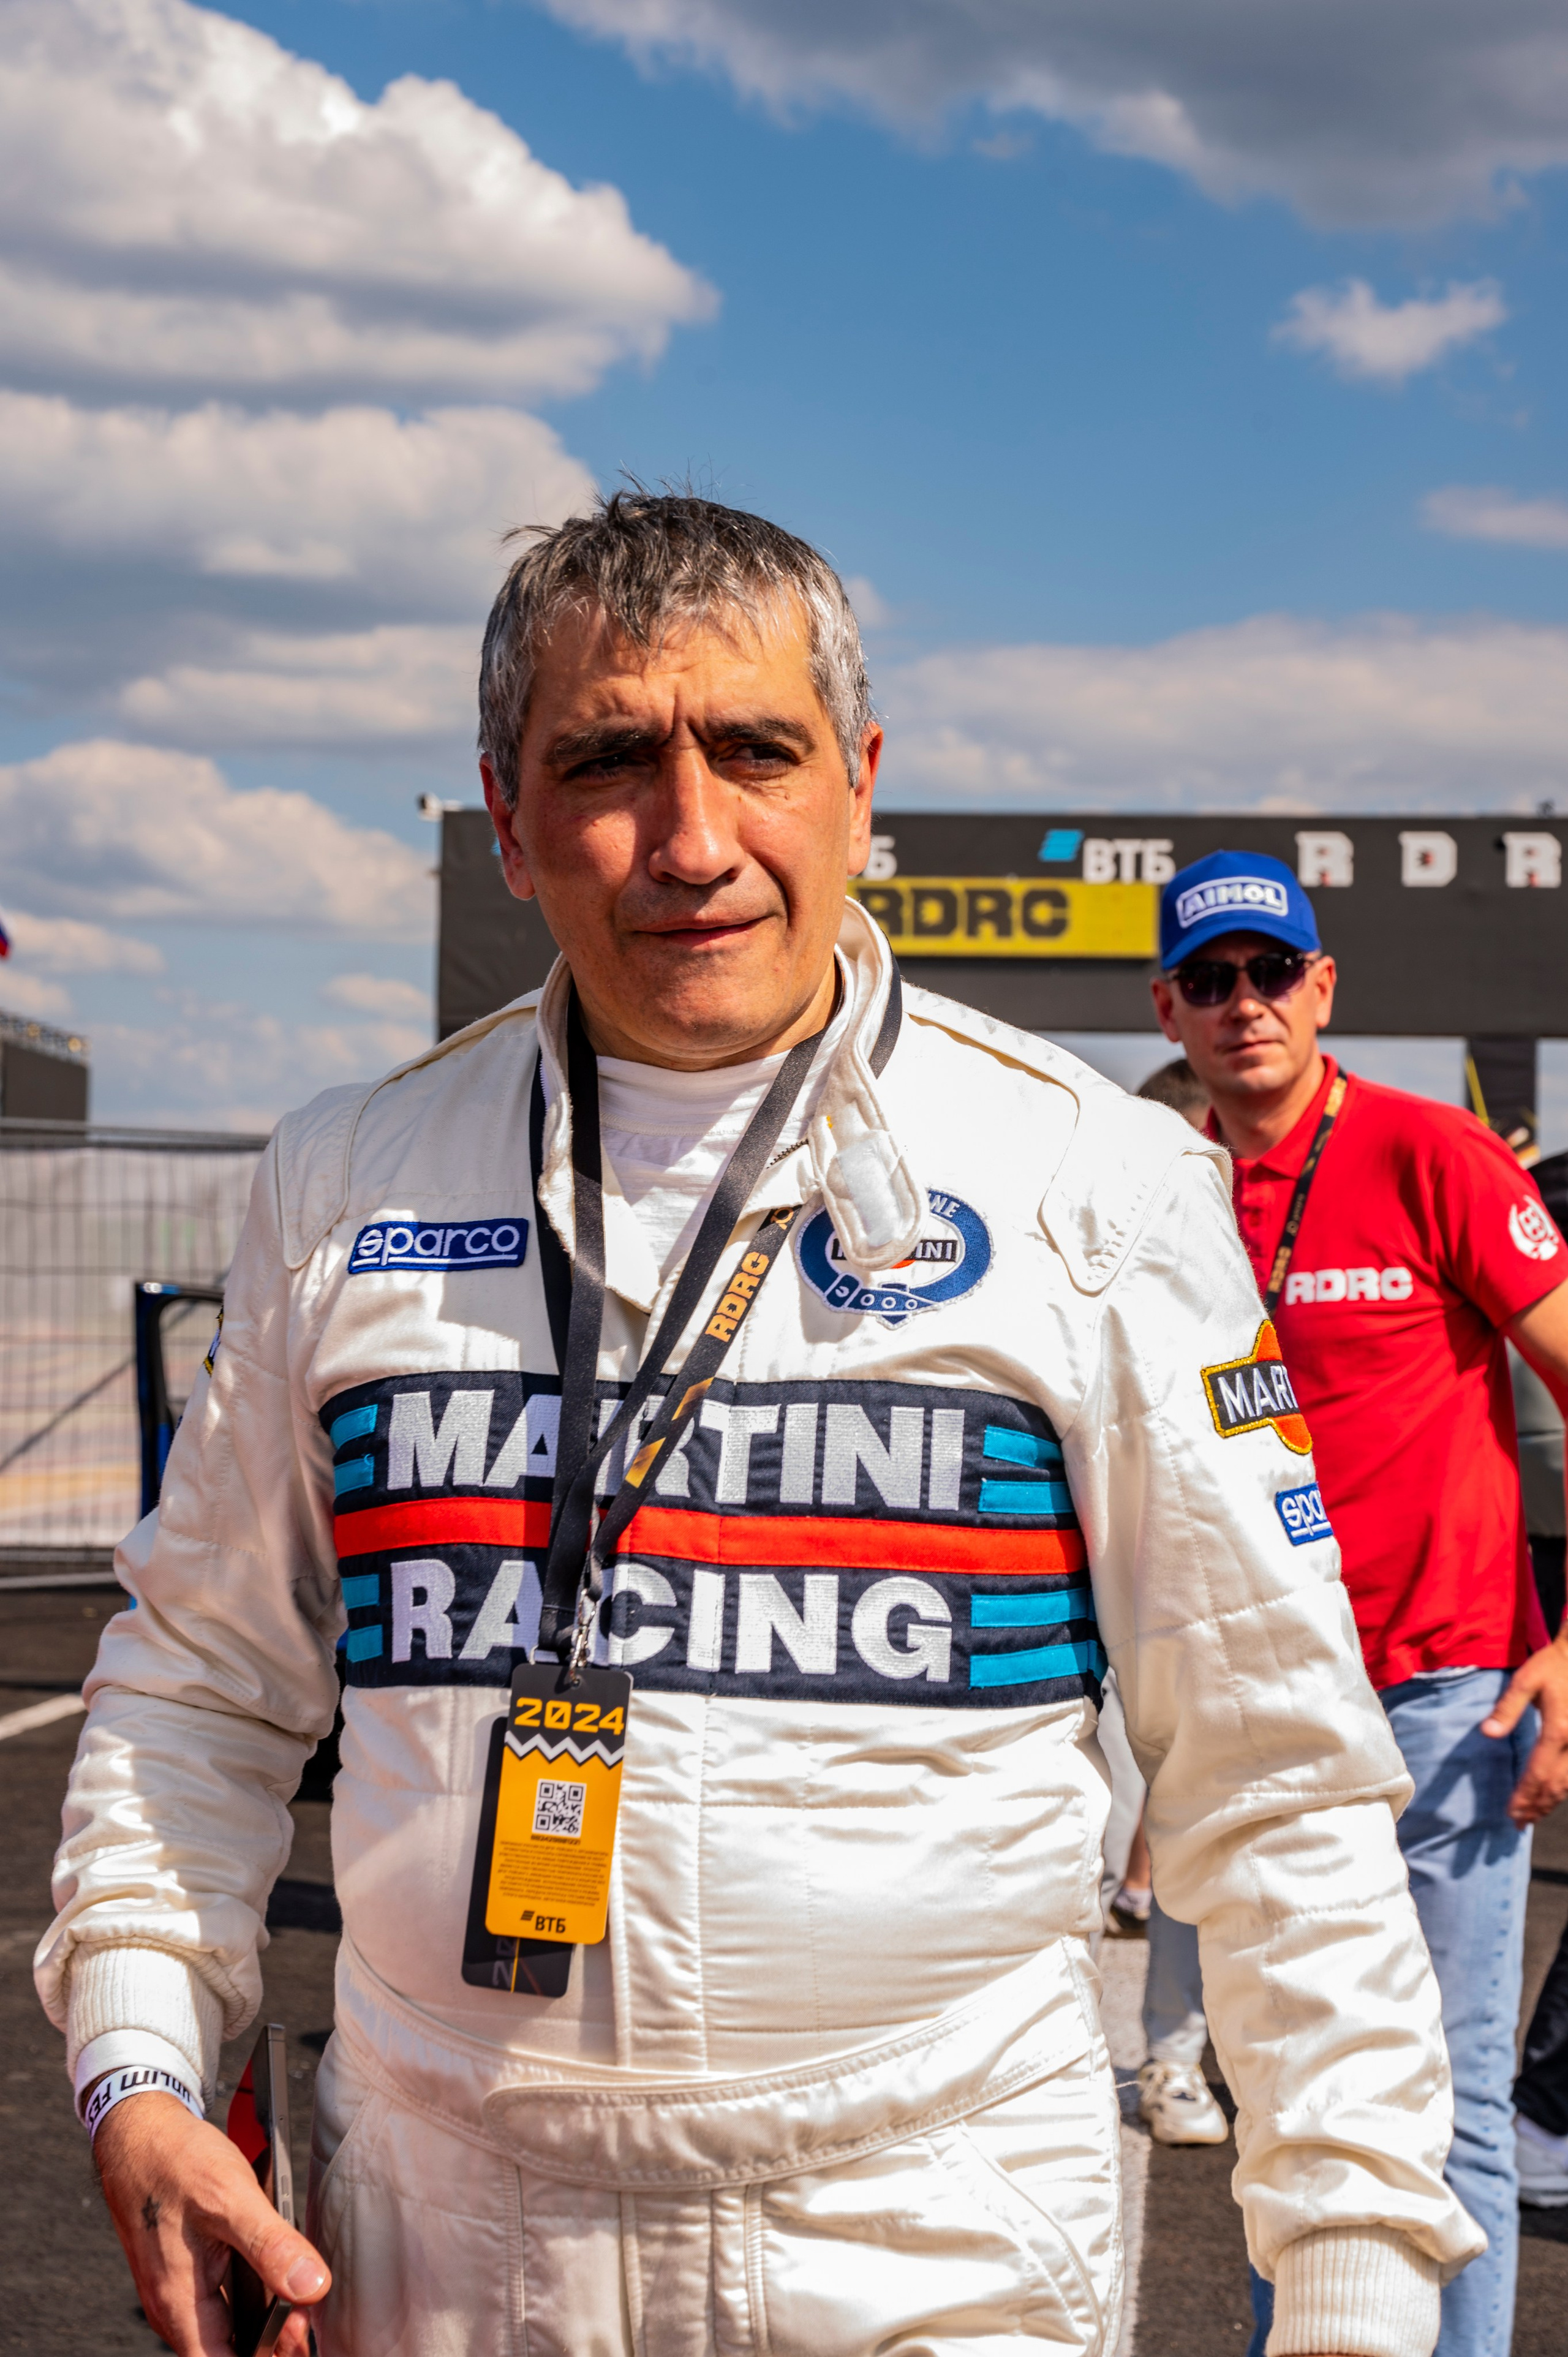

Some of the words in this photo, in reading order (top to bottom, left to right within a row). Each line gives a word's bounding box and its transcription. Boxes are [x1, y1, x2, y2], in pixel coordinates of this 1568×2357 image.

[1183, 882, 1283, 919] AIMOL
[357, 1224, 521, 1266] sparco
[704, 1251, 770, 1343] RDRC
[1285, 1266, 1414, 1306] RDRC
[390, 1558, 953, 1683] RACING
[514, 1697, 625, 1736] 2024
[534, 1915, 566, 1933] ВТБ
